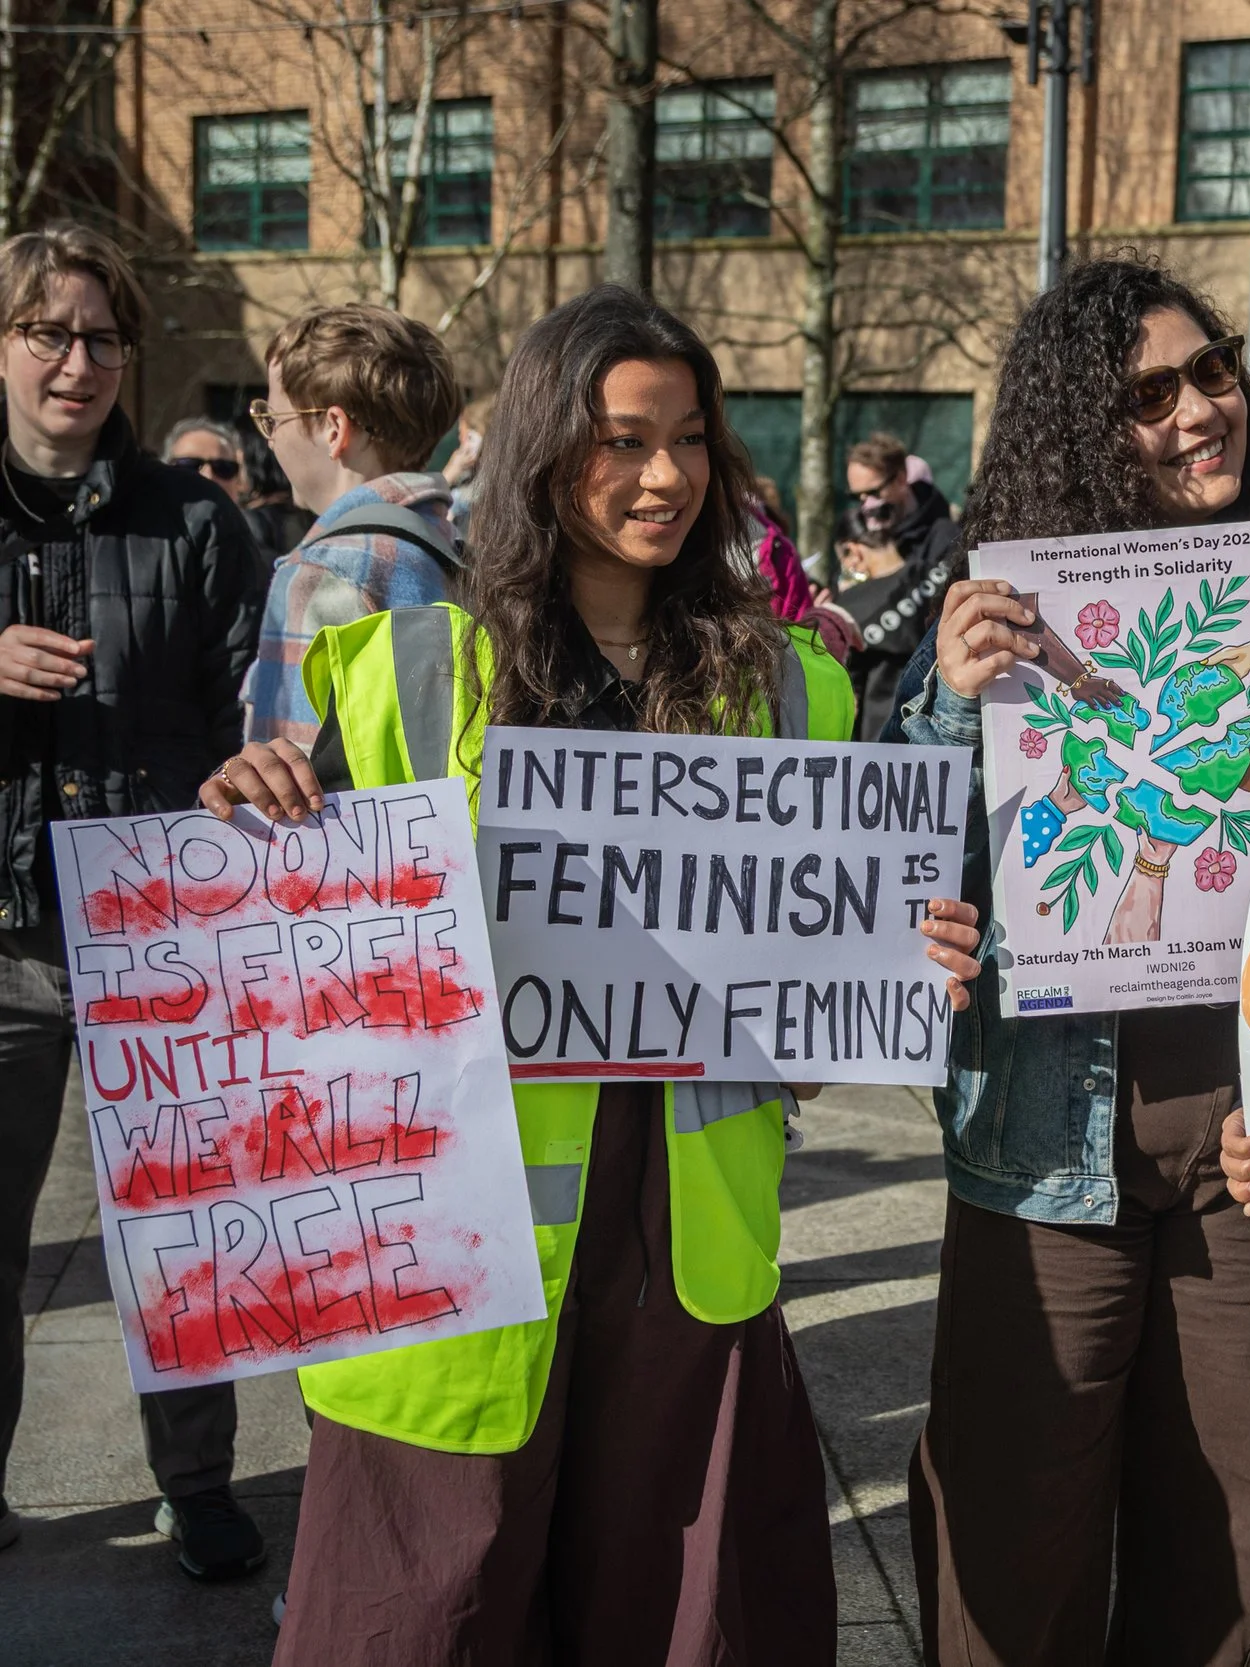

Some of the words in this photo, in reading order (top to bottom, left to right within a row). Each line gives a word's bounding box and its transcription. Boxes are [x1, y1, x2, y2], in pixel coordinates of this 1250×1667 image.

[1030, 543, 1121, 562] International
[1123, 538, 1189, 554] Women's
[1193, 537, 1220, 550] Day
[1057, 565, 1131, 584] Strength
[1135, 564, 1150, 578] in
[1153, 558, 1233, 576] Solidarity
[497, 748, 958, 836] INTERSECTIONAL
[68, 816, 256, 936] NO
[265, 794, 446, 914] ONE
[496, 842, 880, 936] FEMINISN
[902, 853, 940, 885] IS
[77, 942, 208, 1026] IS
[218, 909, 479, 1033] FREE
[1017, 951, 1079, 965] Saturday
[1081, 948, 1104, 961] 7th
[1108, 945, 1151, 959] March
[1167, 941, 1226, 955] 11.30am
[1109, 975, 1238, 994] reclaimtheagenda.com
[1146, 961, 1196, 974] IWDNI26
[503, 975, 701, 1060] ONLY
[724, 980, 952, 1068] FEMINISM
[1019, 997, 1073, 1011] AGENDA
[1146, 995, 1166, 1003] Design
[1167, 994, 1175, 1002] by
[89, 1030, 305, 1101] UNTIL
[92, 1097, 235, 1201] WE
[260, 1072, 437, 1182] ALL
[118, 1172, 461, 1372] FREE
